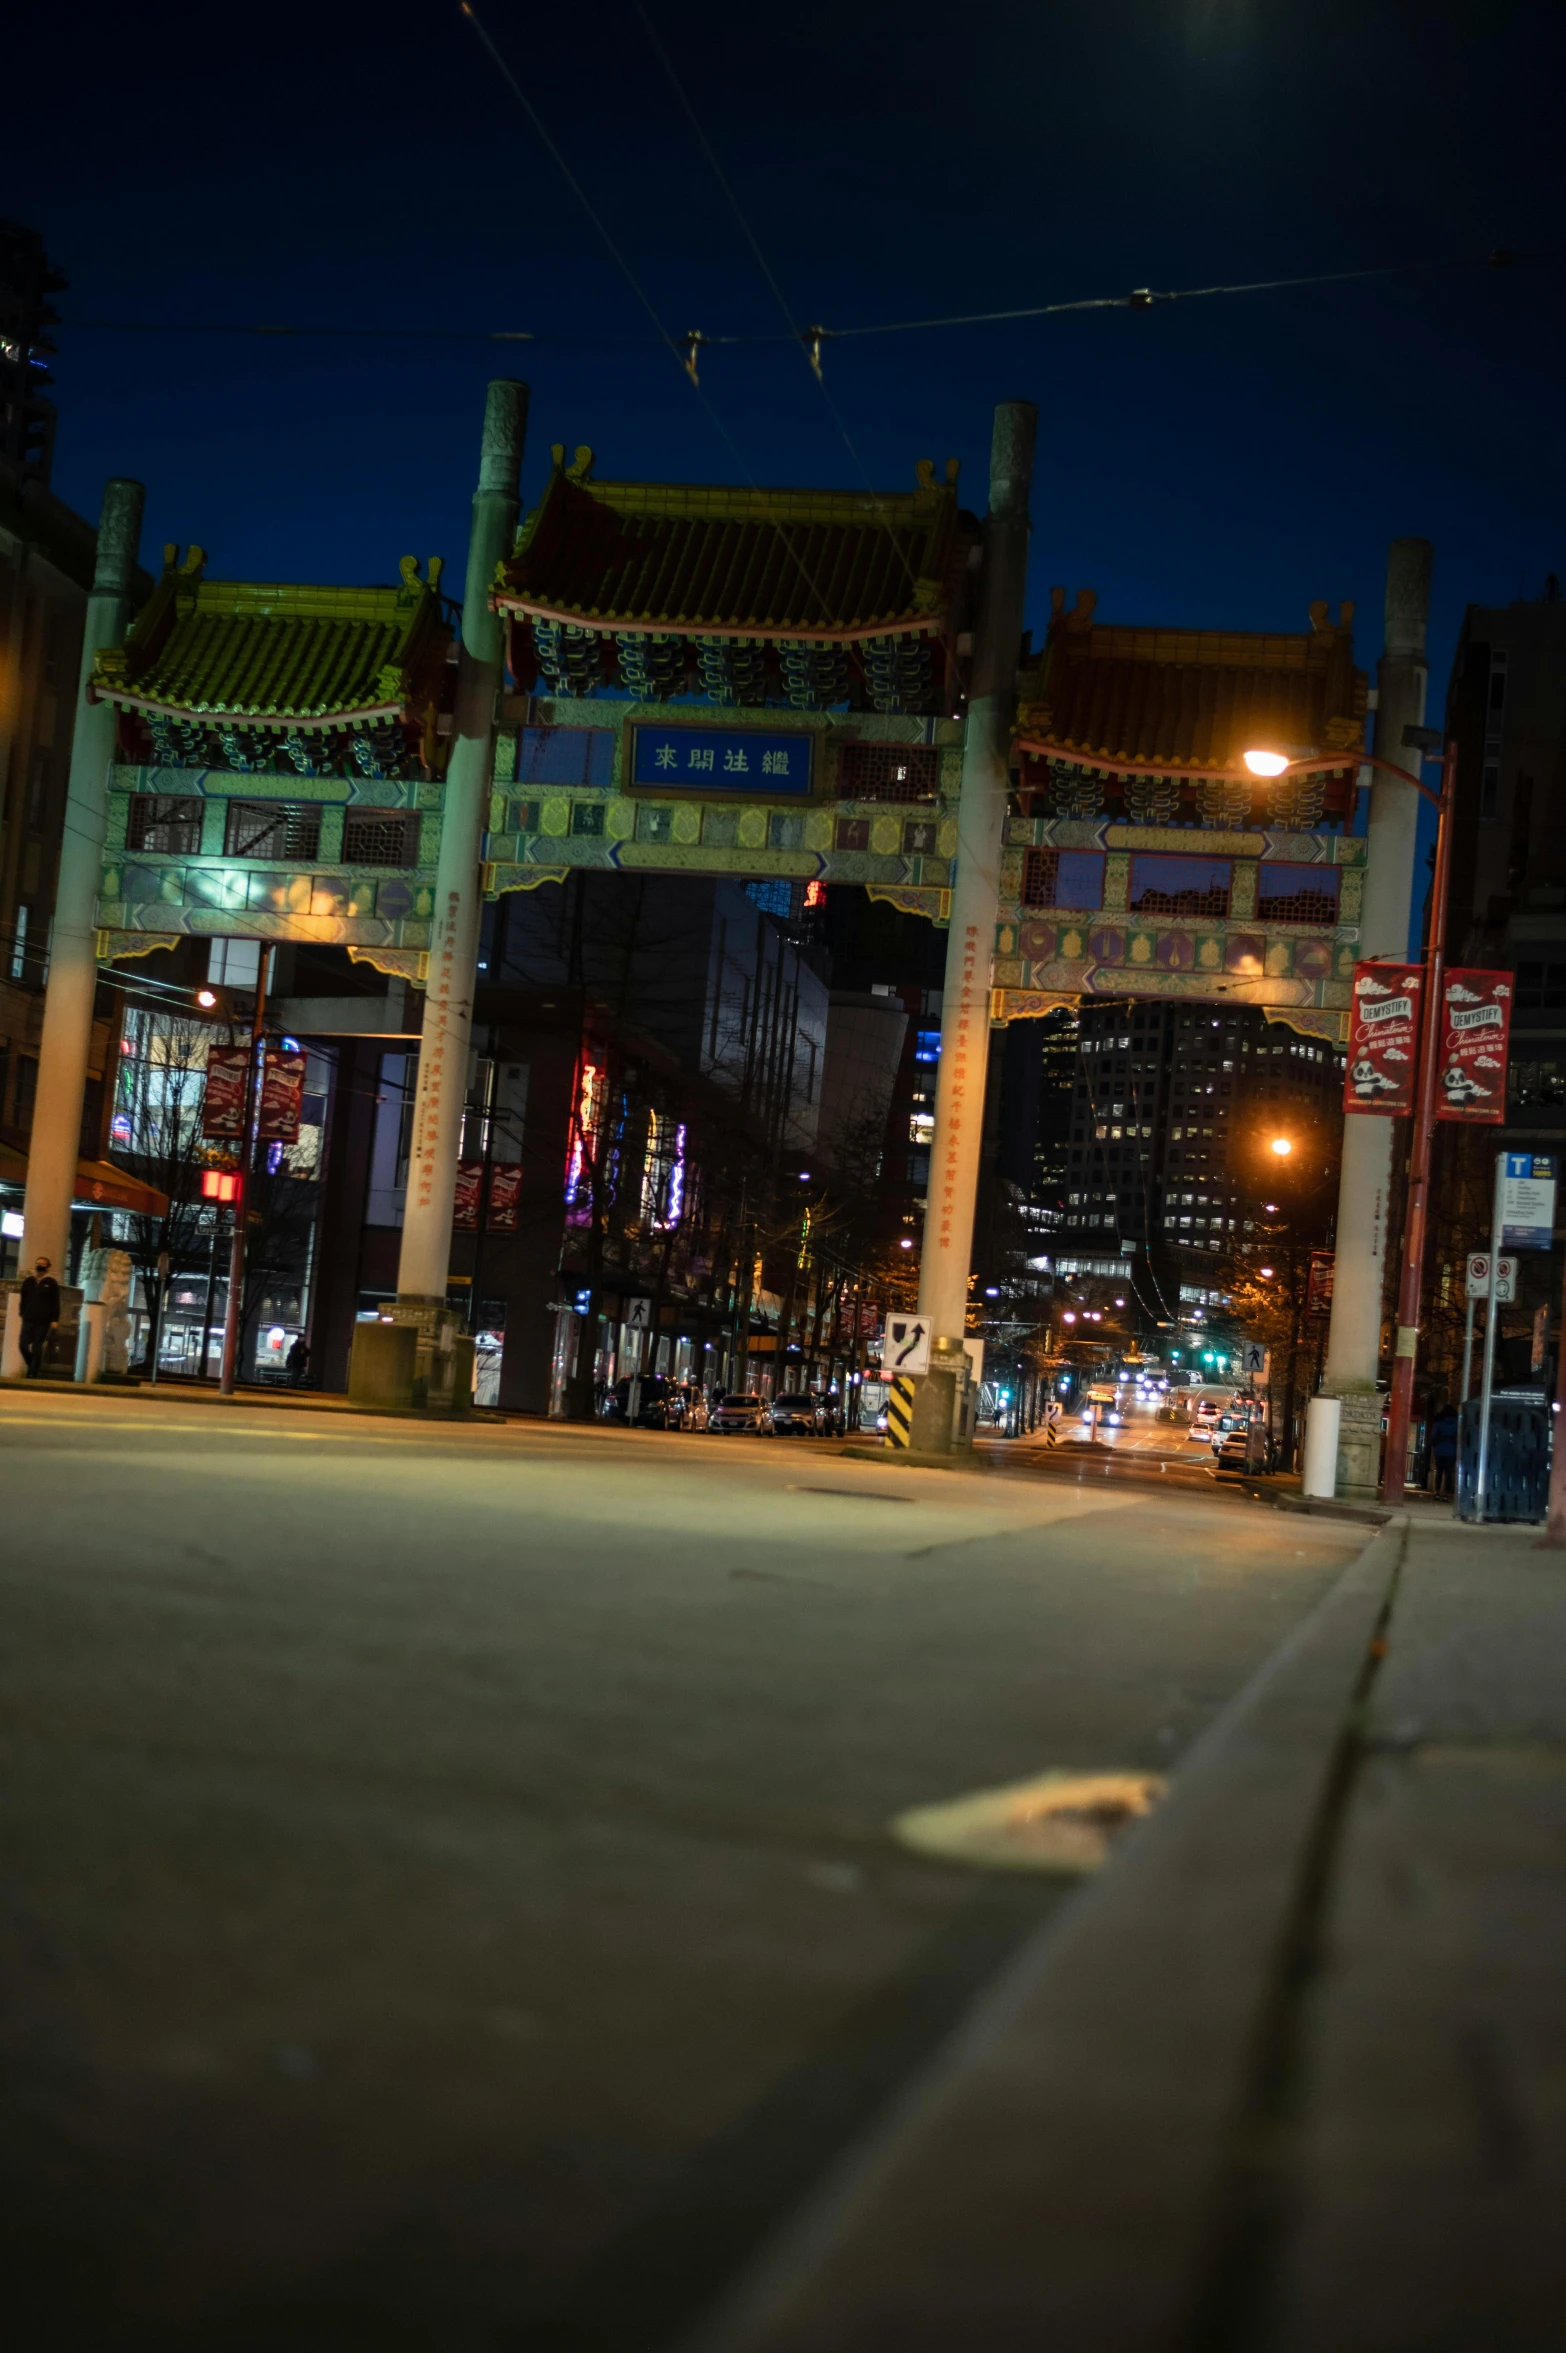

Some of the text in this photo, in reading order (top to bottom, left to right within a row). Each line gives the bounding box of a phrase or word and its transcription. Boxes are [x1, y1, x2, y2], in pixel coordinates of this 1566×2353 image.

[1363, 1000, 1408, 1020] DEMYSTIFY
[1454, 1008, 1499, 1028] DEMYSTIFY
[1355, 1020, 1414, 1042] Chinatown
[1446, 1028, 1505, 1049] Chinatown
[1511, 1157, 1527, 1176] T
